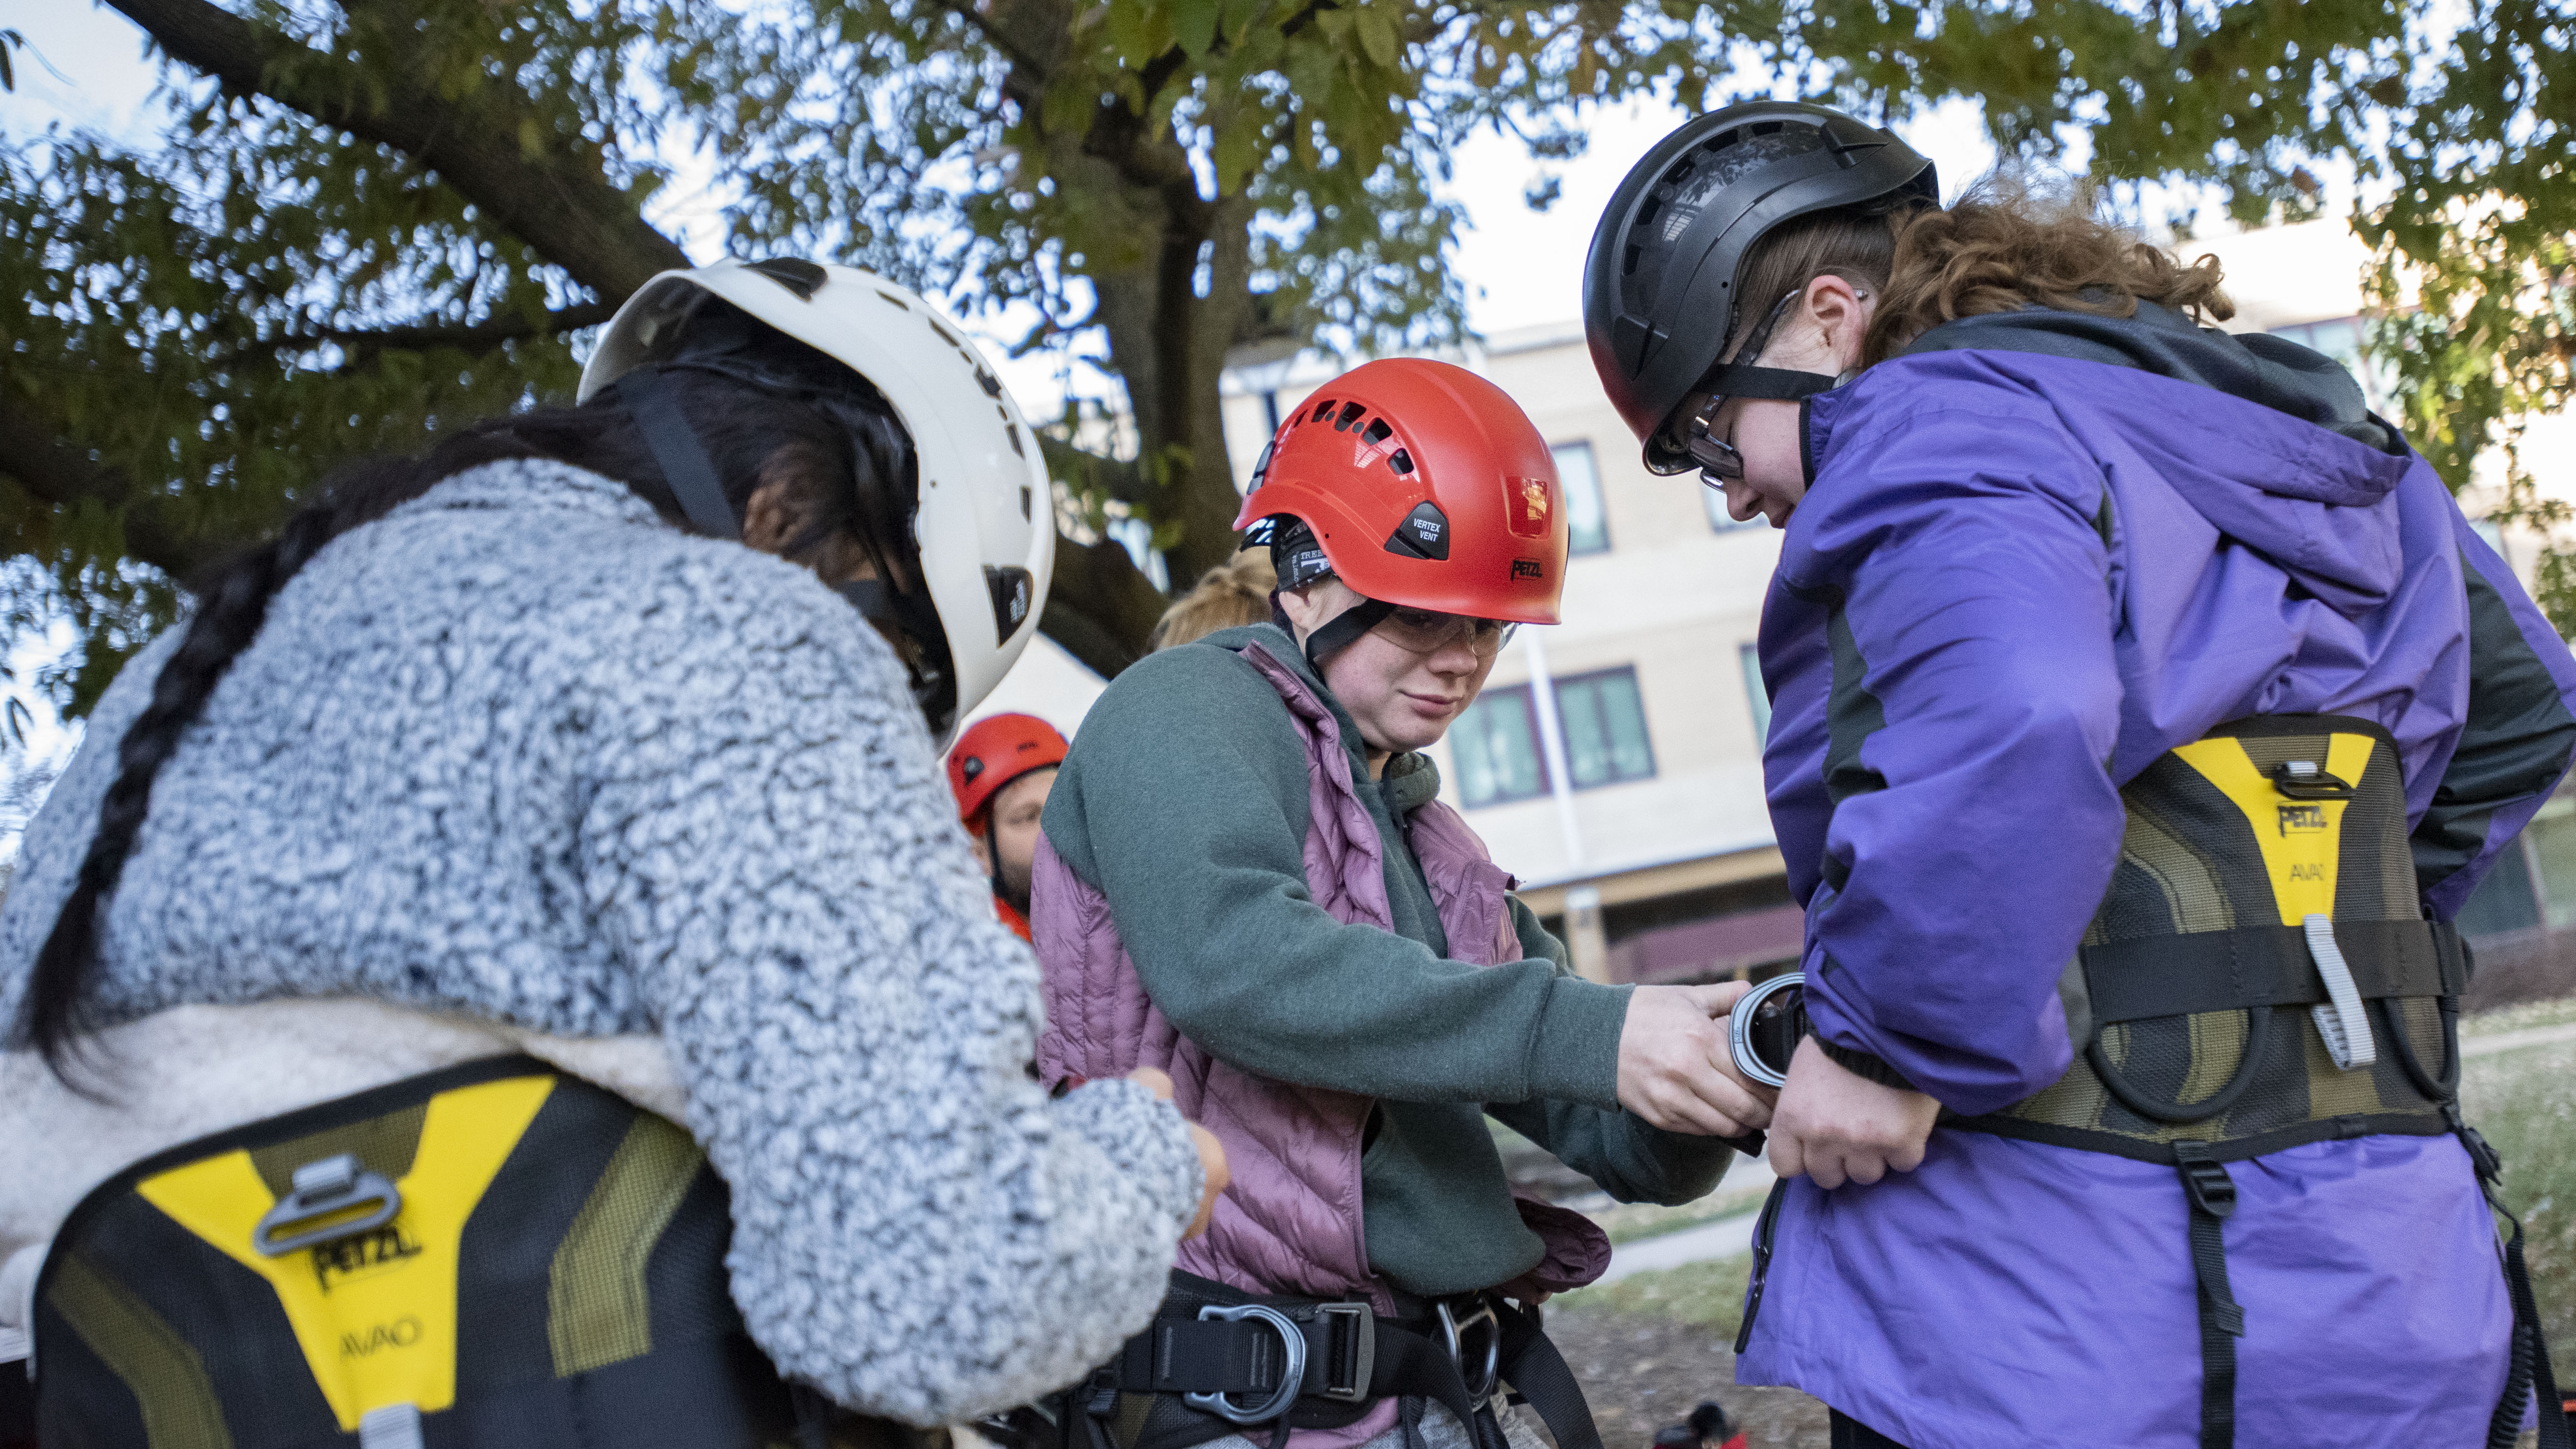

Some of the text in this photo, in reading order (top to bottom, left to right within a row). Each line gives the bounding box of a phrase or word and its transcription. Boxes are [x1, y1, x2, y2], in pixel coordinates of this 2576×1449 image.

[1414, 518, 1441, 532] VERTEX
[1420, 531, 1438, 542] VENT
[1510, 560, 1542, 582] PETZL
[2277, 806, 2327, 838] PETZL
[312, 1227, 423, 1295] PETZL
[339, 1315, 424, 1360] AVAO
